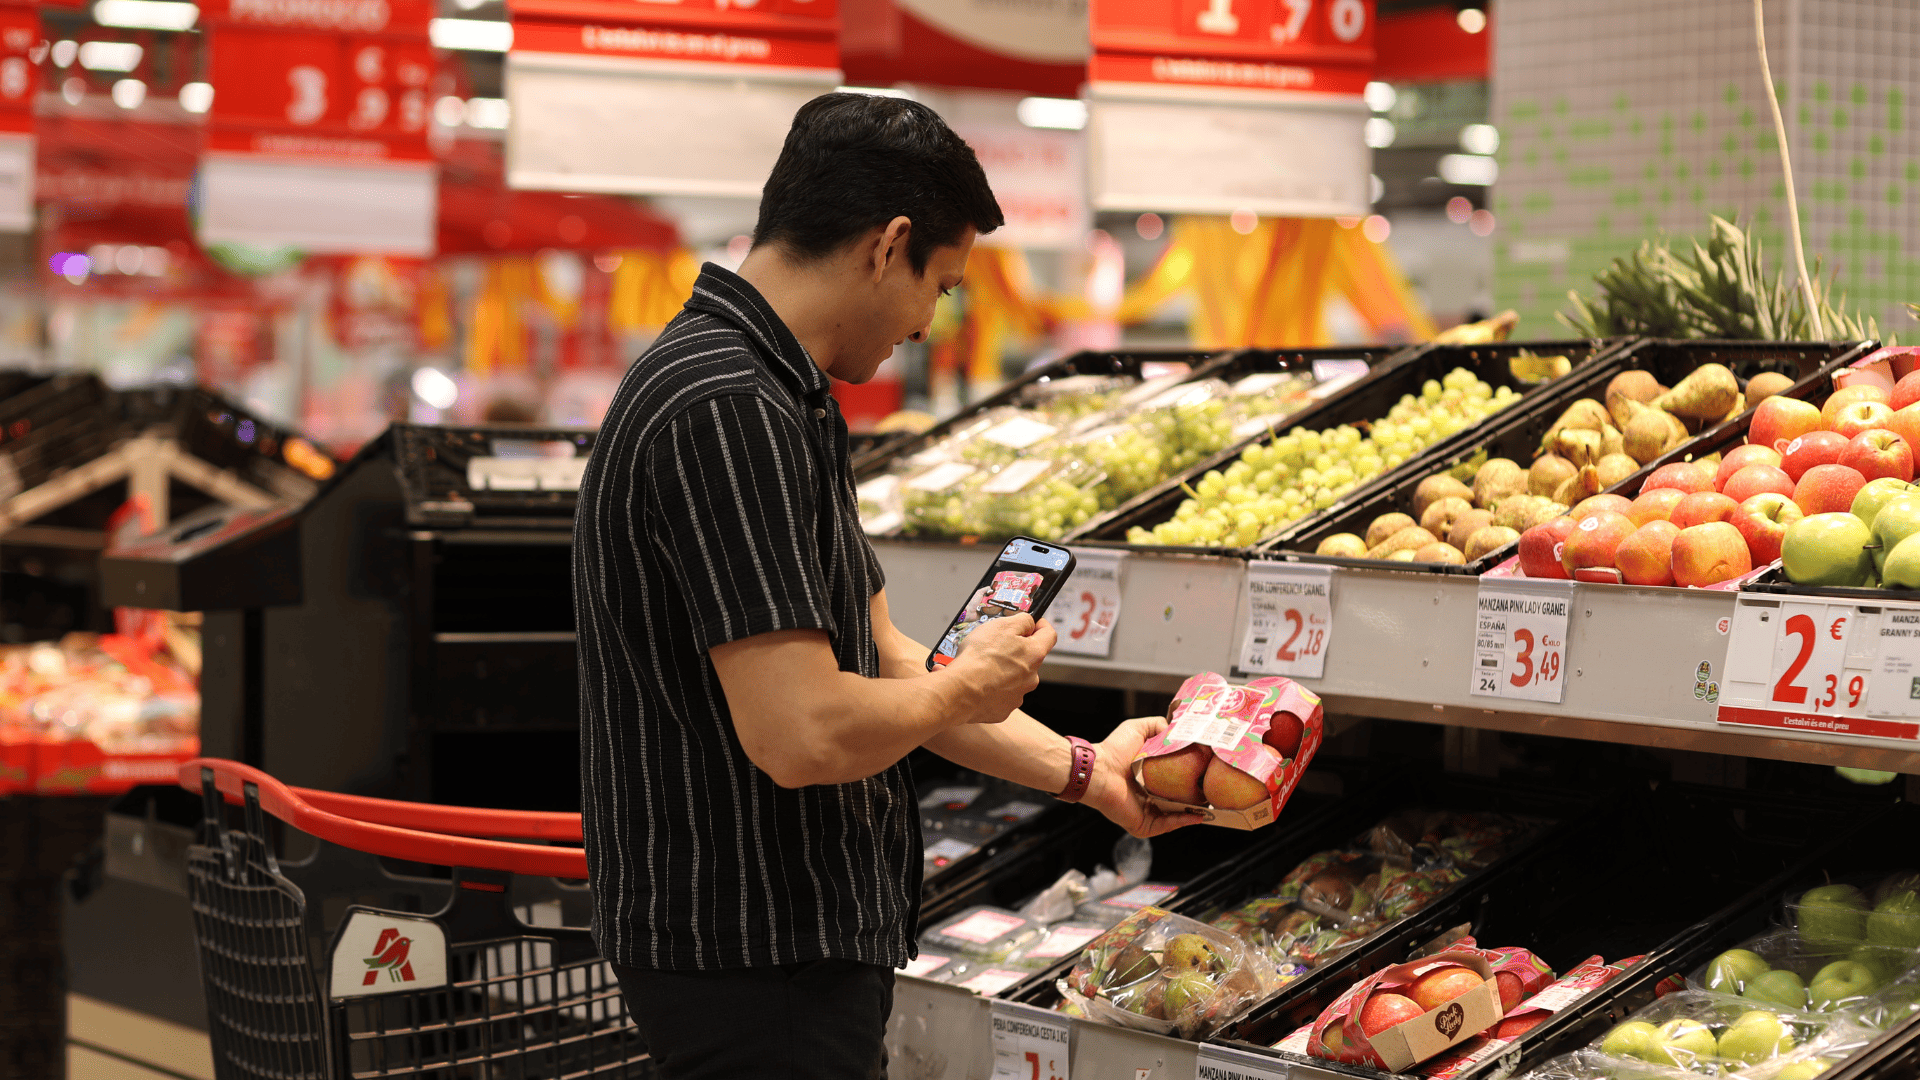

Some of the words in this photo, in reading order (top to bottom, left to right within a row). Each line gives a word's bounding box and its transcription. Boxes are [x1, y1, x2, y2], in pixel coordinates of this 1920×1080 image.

[1479, 598, 1508, 612] MANZANA
[1510, 600, 1524, 613] PINK
[1525, 601, 1541, 614] LADY
[1542, 603, 1566, 616] GRANEL
[1479, 621, 1505, 630] ESPAÑA
[1880, 628, 1911, 637] GRANNY
[1477, 639, 1494, 649] 80/85
[1479, 678, 1496, 691] 24
[1784, 717, 1810, 727] L'estalvi
[1819, 720, 1827, 728] en
[1834, 722, 1849, 731] preu
[1440, 1006, 1458, 1029] Pink
[1445, 1013, 1462, 1035] Lady
[994, 1018, 1006, 1030] PERA
[1007, 1020, 1039, 1037] CONFERENCIA
[1041, 1027, 1056, 1040] CESTA
[1199, 1065, 1227, 1080] MANZANA
